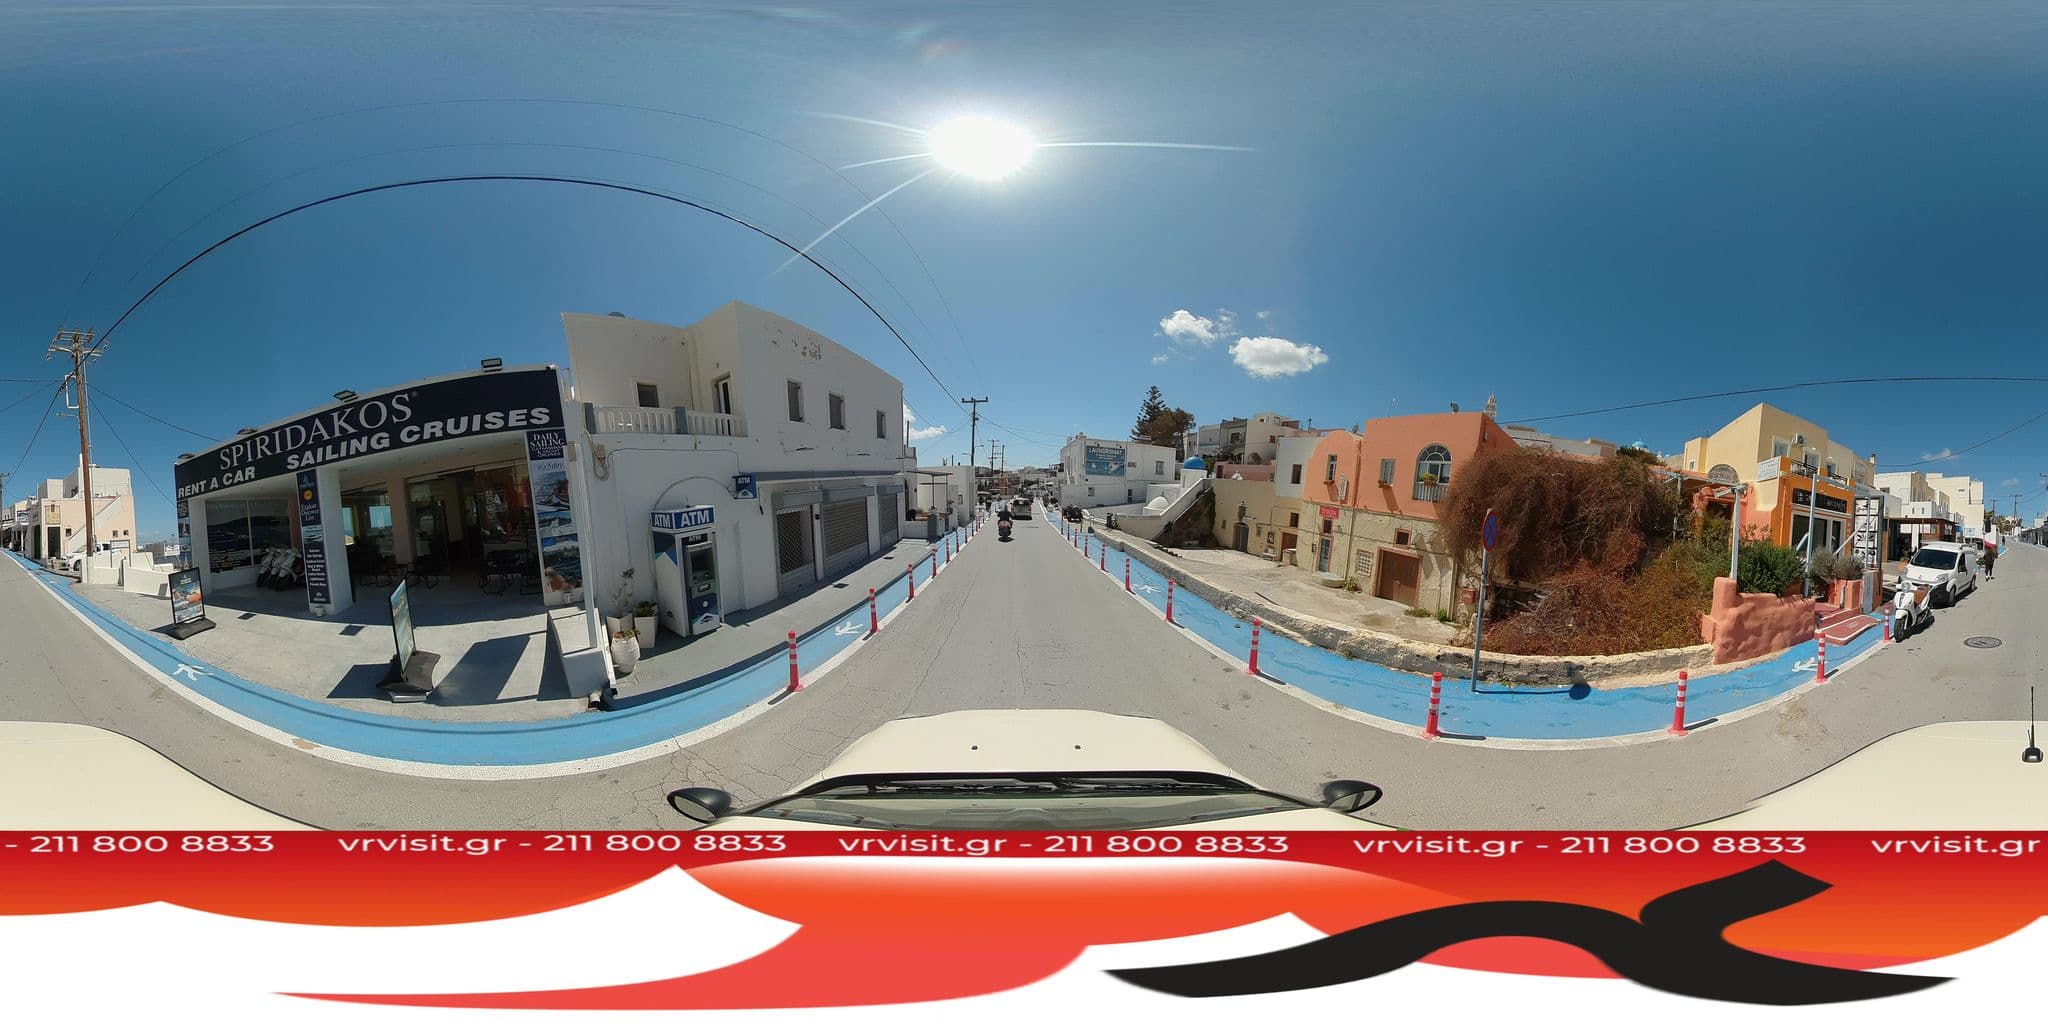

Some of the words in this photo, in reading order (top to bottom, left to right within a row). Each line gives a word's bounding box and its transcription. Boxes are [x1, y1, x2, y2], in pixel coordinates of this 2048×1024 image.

[286, 432, 391, 470] SAILING
[400, 407, 551, 443] CRUISES
[530, 438, 565, 448] SAILING
[533, 432, 560, 441] DAILY
[178, 478, 207, 499] RENT
[209, 477, 219, 490] A
[222, 466, 256, 486] CAR
[738, 476, 751, 484] ATM
[654, 513, 671, 529] ATM
[680, 509, 710, 528] ATM
[688, 535, 703, 543] ATM
